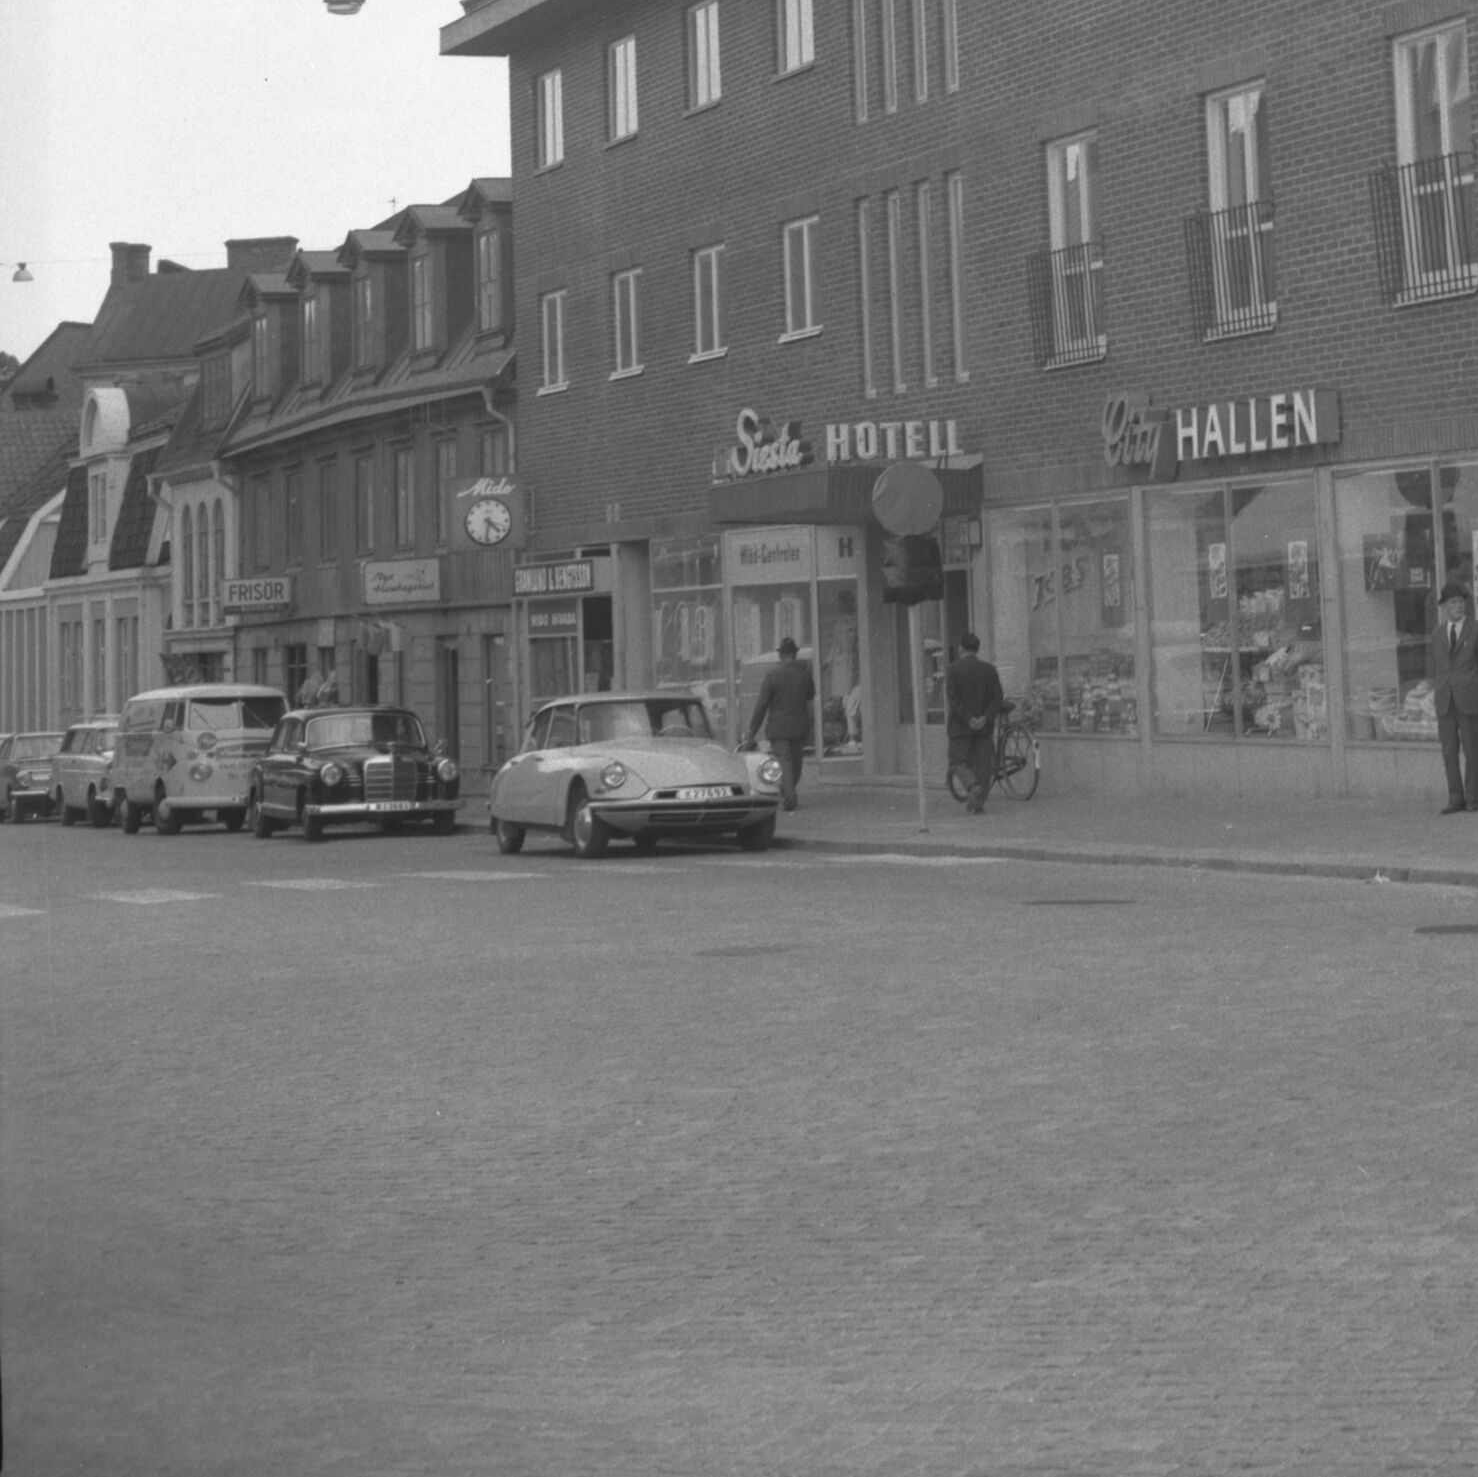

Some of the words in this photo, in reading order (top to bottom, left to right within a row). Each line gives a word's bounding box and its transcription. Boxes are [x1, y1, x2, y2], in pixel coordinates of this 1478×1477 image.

[731, 408, 804, 476] Siesta
[825, 419, 965, 462] HOTELL
[1101, 390, 1165, 481] City
[1175, 388, 1318, 461] HALLEN
[456, 477, 517, 498] Mido
[229, 580, 284, 602] FRISÖR
